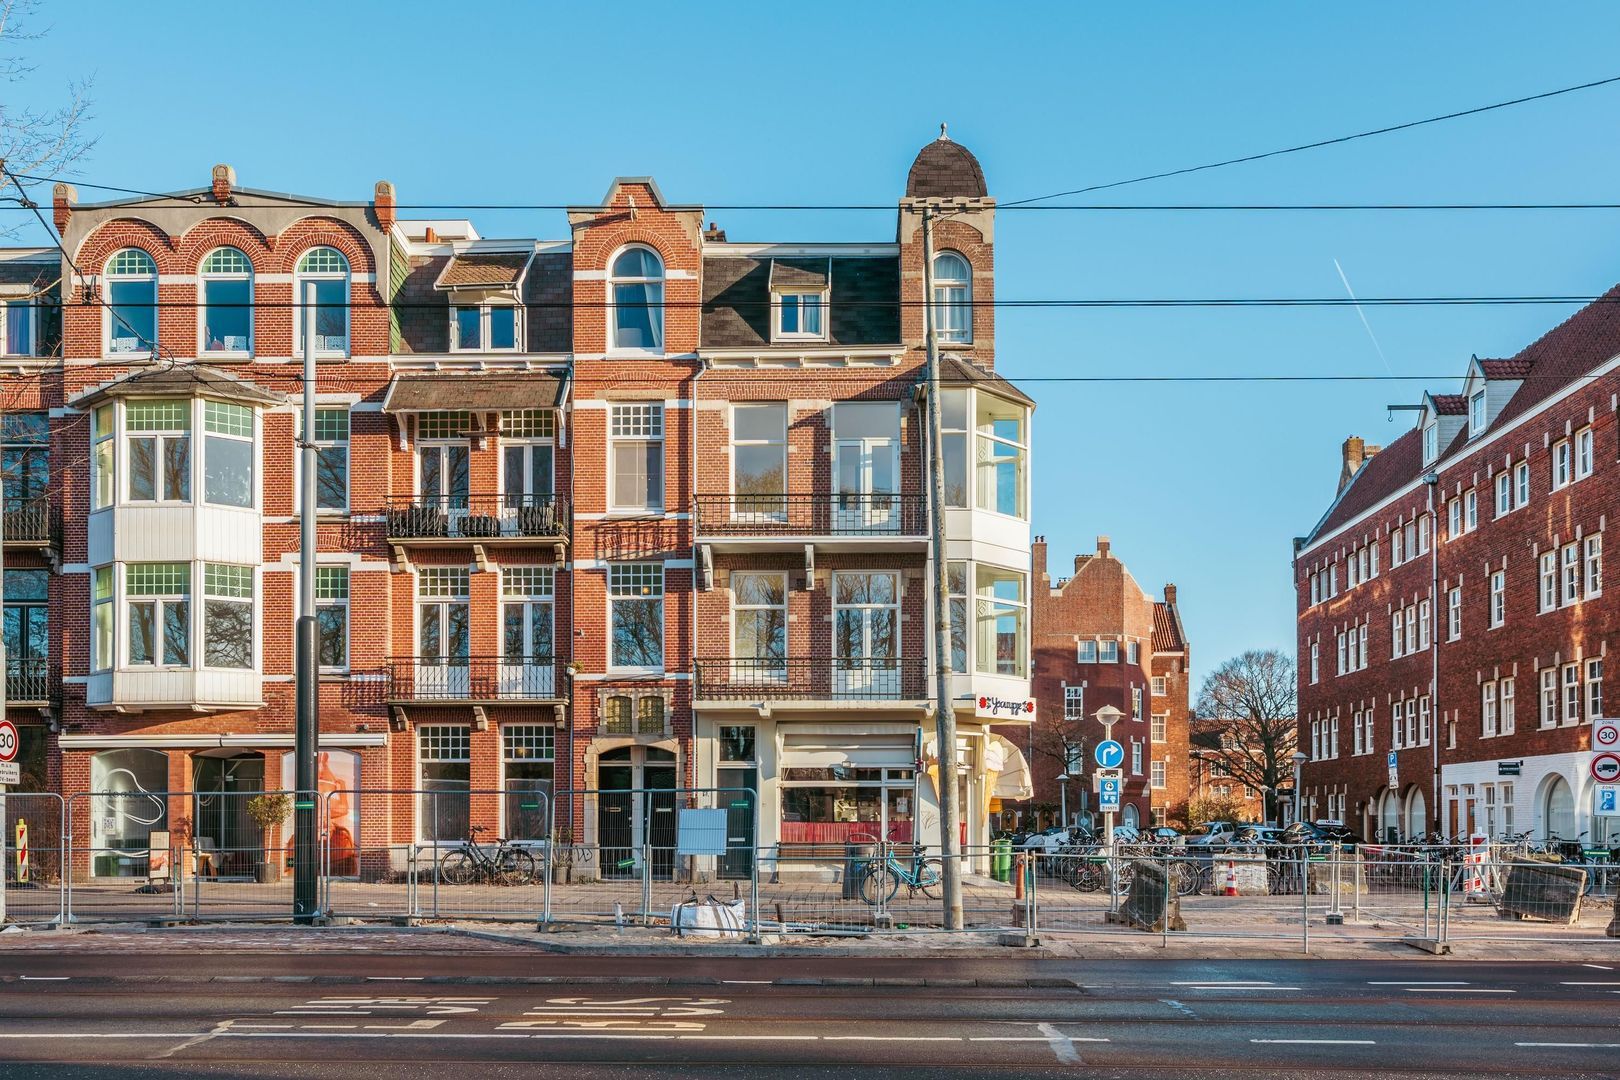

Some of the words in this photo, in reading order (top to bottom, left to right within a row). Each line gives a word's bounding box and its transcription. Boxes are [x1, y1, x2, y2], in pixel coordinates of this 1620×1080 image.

[0, 733, 13, 748] 30
[1601, 731, 1615, 740] 30
[1604, 792, 1612, 802] P
[494, 997, 732, 1031] BUS
